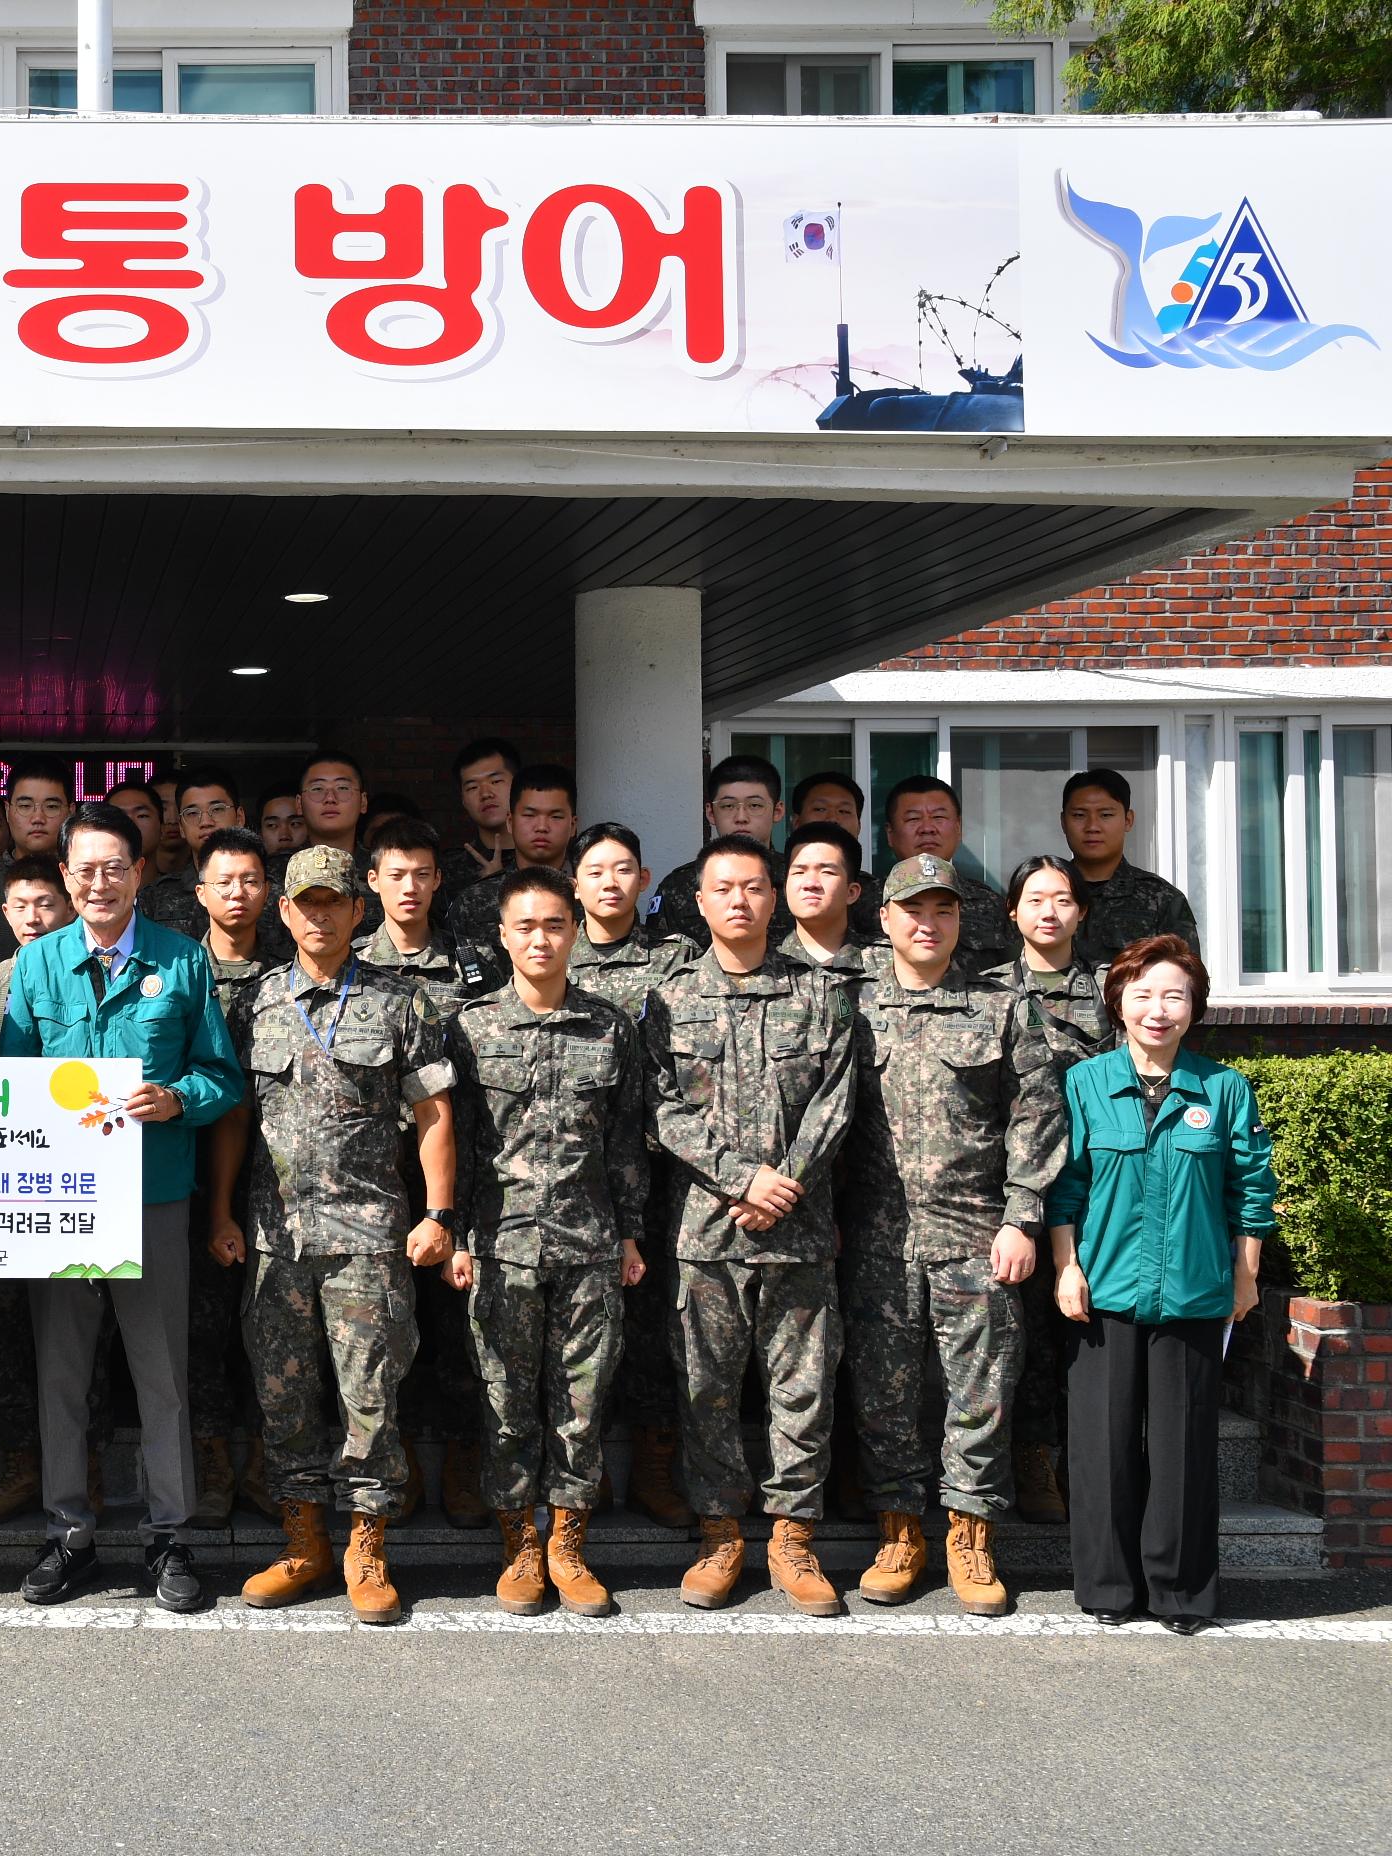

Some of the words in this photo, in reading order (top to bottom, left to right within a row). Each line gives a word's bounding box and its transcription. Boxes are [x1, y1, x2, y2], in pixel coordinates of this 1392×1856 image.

[294, 182, 726, 367] 방어
[17, 1172, 53, 1195] 장병
[60, 1172, 97, 1195] 위문
[59, 1212, 96, 1235] 전달
